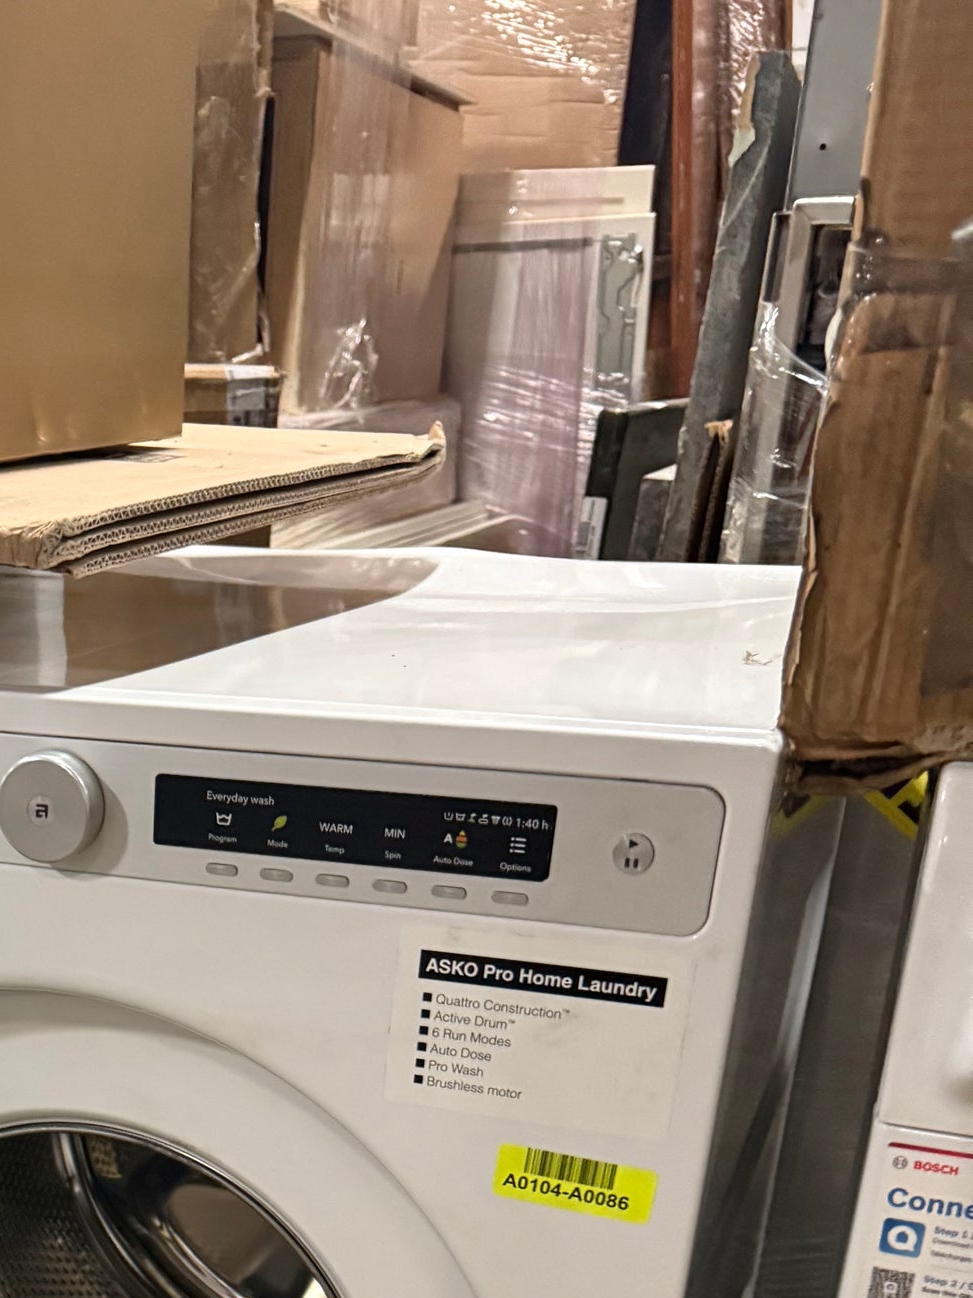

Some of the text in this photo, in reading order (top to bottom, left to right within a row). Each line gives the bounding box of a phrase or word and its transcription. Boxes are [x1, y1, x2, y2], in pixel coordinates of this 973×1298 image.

[207, 790, 275, 806] Everyday wash
[319, 821, 354, 834] WARM
[515, 818, 549, 830] 1:40 h
[208, 832, 237, 844] Program
[384, 827, 406, 840] MIN
[267, 838, 289, 848] Mode
[325, 844, 345, 854] Temp
[385, 850, 401, 860] Spin
[433, 855, 474, 867] Auto Dose
[499, 862, 532, 874] Options
[425, 958, 658, 1002] ASKO Pro Home Laundry
[435, 993, 481, 1009] Quattro
[433, 1010, 471, 1024] Active
[431, 1027, 512, 1048] 6 Run Modes
[429, 1044, 492, 1062] Auto Dose
[429, 1060, 484, 1078] Pro Wash
[427, 1076, 523, 1100] Brushless motor
[913, 1160, 959, 1176] BOSCH
[503, 1173, 630, 1210] A0104-A0086
